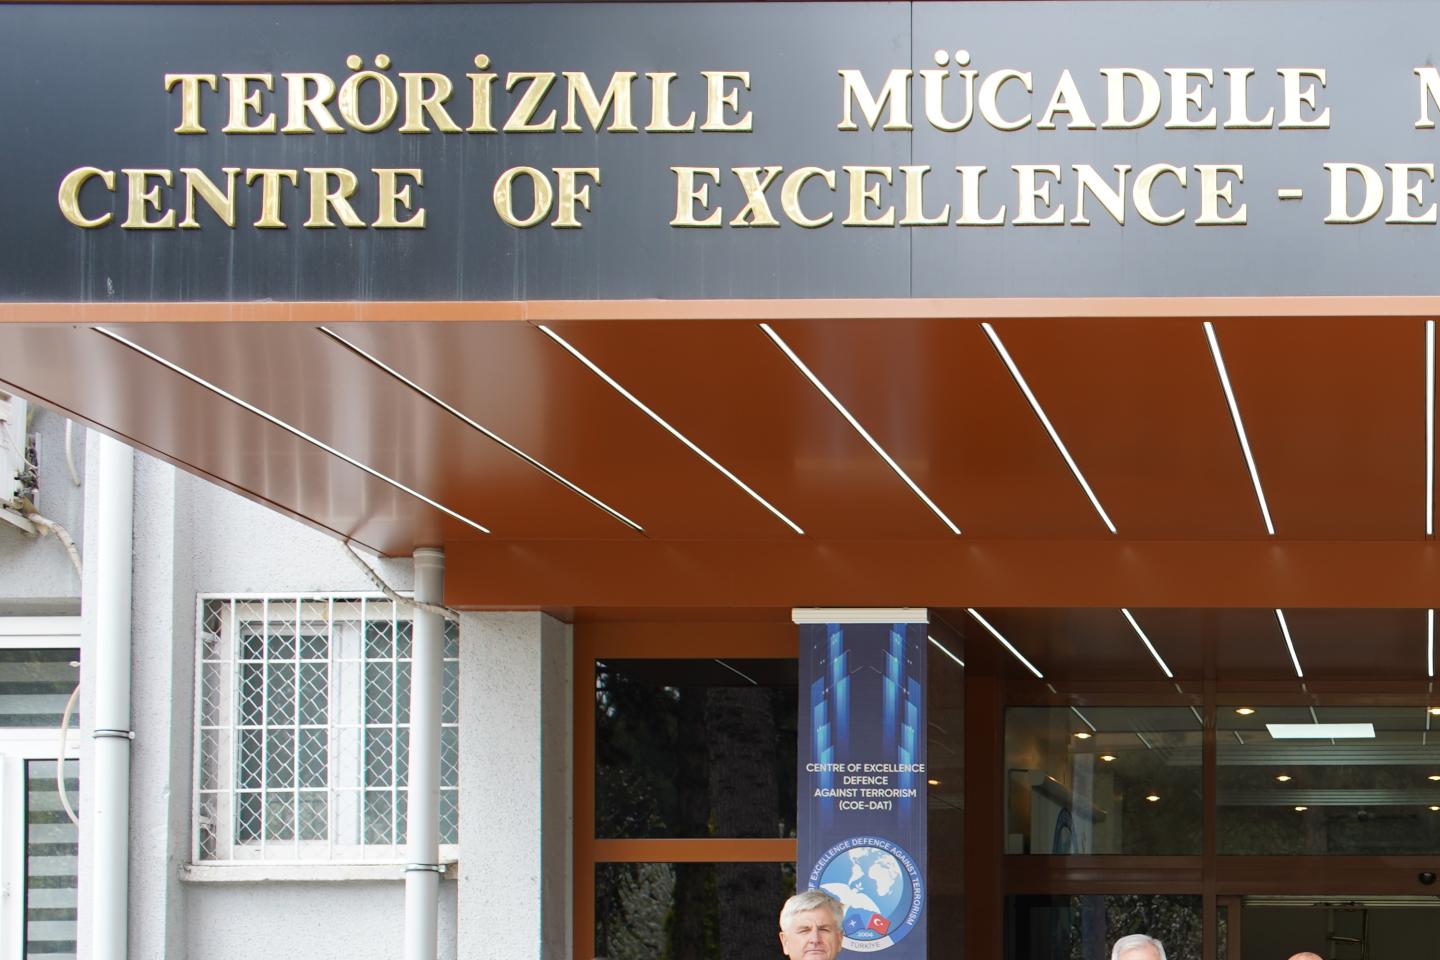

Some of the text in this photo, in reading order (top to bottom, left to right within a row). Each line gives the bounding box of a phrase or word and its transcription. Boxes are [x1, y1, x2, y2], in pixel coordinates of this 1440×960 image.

[164, 54, 752, 134] TERÖRİZMLE
[837, 49, 1330, 132] MÜCADELE
[58, 166, 425, 230] CENTRE
[492, 166, 600, 229] OF
[670, 163, 1247, 228] EXCELLENCE
[806, 763, 925, 772] CENTRE OF EXCELLENCE
[843, 776, 888, 785] DEFENCE
[814, 788, 917, 797] AGAINST TERRORISM
[839, 801, 892, 811] (COE-DAT)
[811, 840, 850, 881] EXCELLENCE
[852, 838, 891, 850] DEFENCE
[890, 847, 917, 877] AGAINST
[907, 877, 921, 926] TERRORISM
